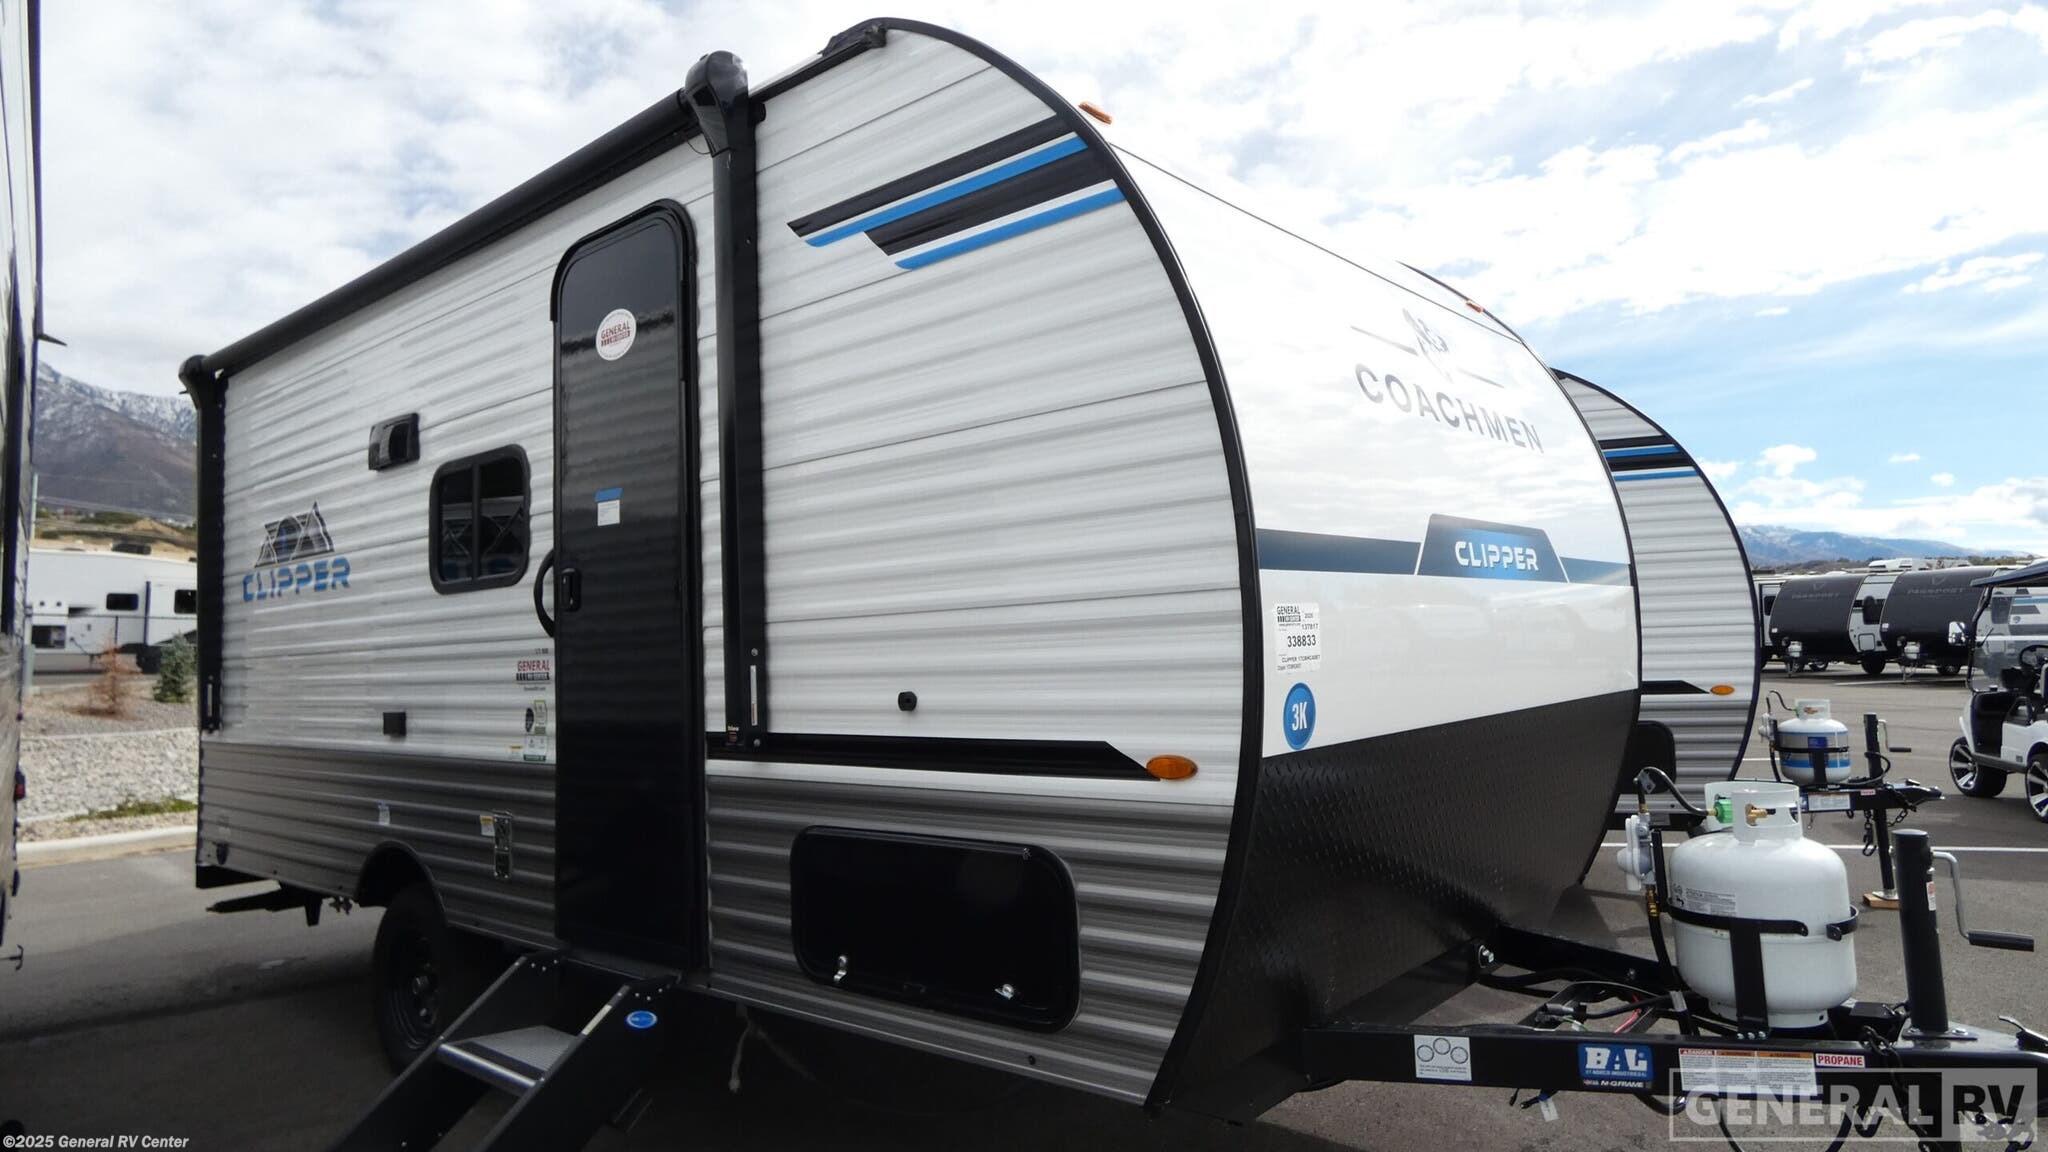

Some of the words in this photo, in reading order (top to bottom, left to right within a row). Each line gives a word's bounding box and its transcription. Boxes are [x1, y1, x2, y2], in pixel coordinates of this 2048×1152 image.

[601, 320, 631, 339] GENERAL
[1354, 363, 1545, 454] COACHMEN
[1454, 541, 1540, 571] CLIPPER
[242, 556, 351, 603] CLIPPER
[1276, 605, 1301, 616] GENERAL
[1287, 634, 1317, 648] 338833
[517, 659, 550, 671] GENERAL
[1291, 701, 1308, 731] 3K
[1585, 1047, 1648, 1071] BAL
[1817, 1055, 1863, 1066] PROPANE
